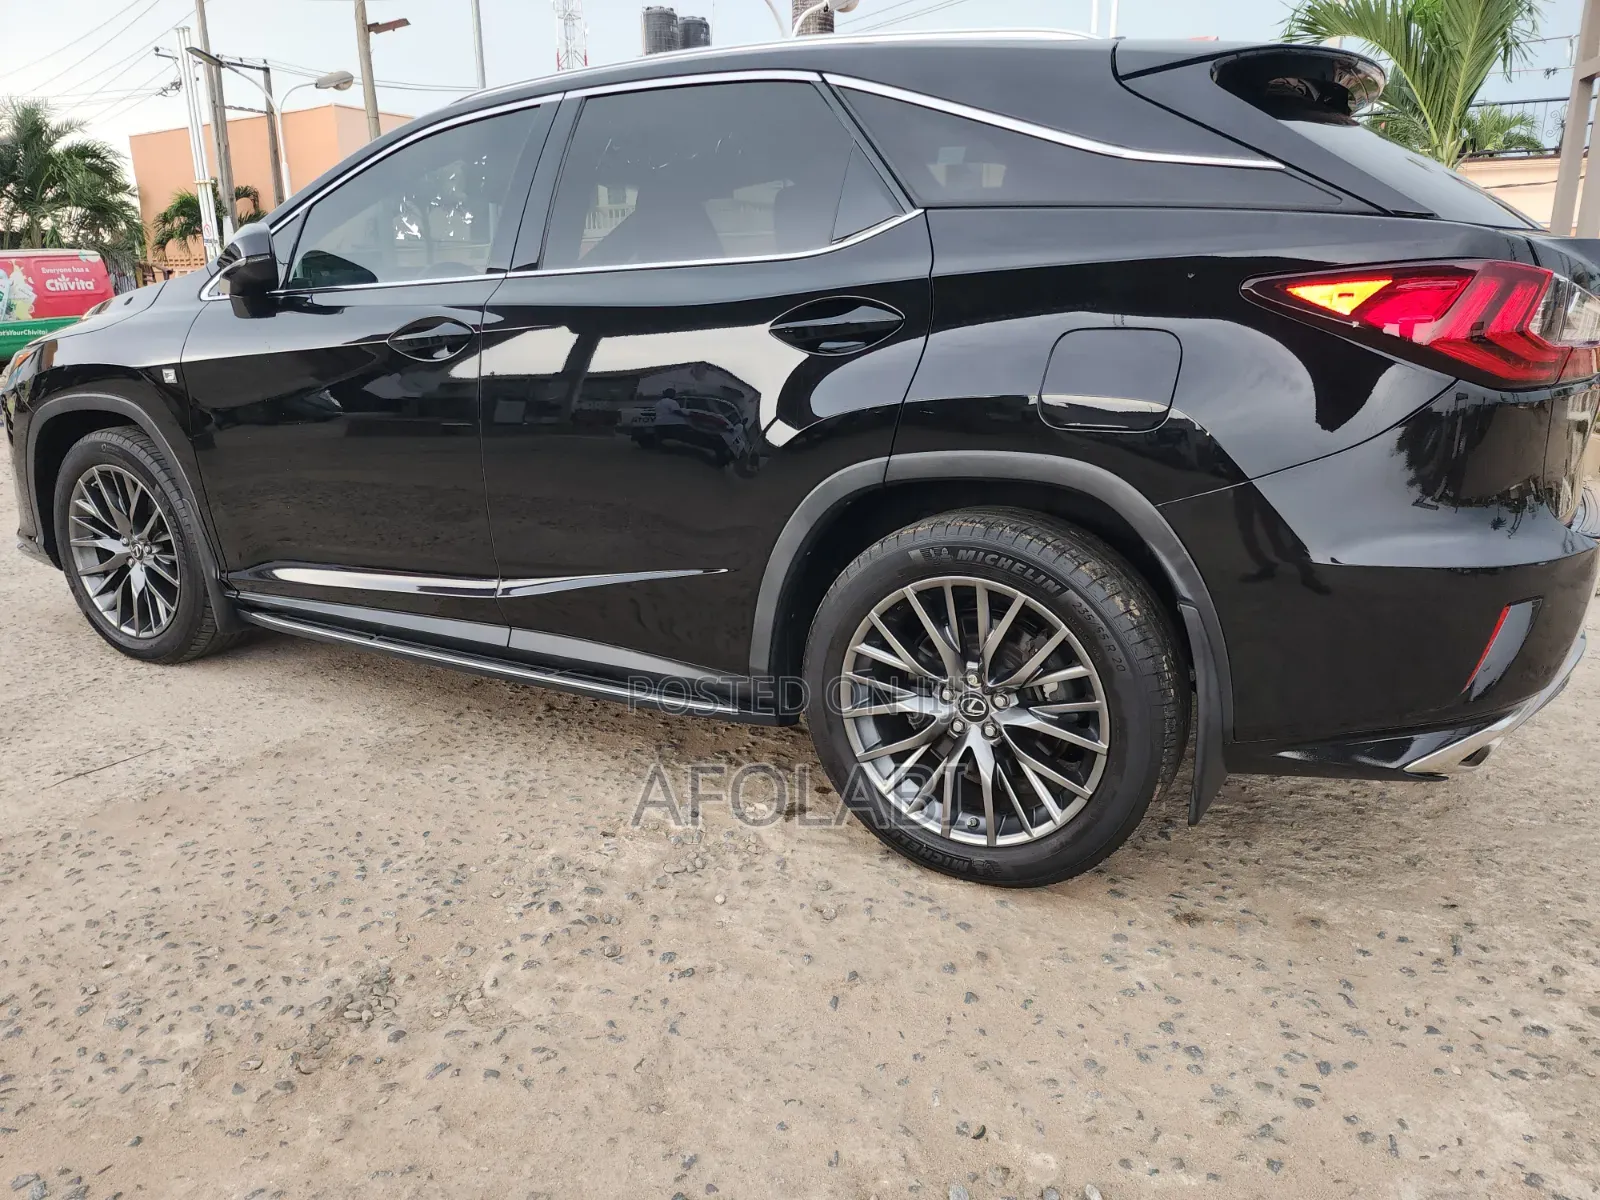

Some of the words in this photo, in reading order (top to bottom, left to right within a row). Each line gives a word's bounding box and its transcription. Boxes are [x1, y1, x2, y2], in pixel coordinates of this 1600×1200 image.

[41, 266, 72, 275] Everyone
[46, 276, 95, 292] Chivita
[956, 549, 1065, 595] MICHELIN
